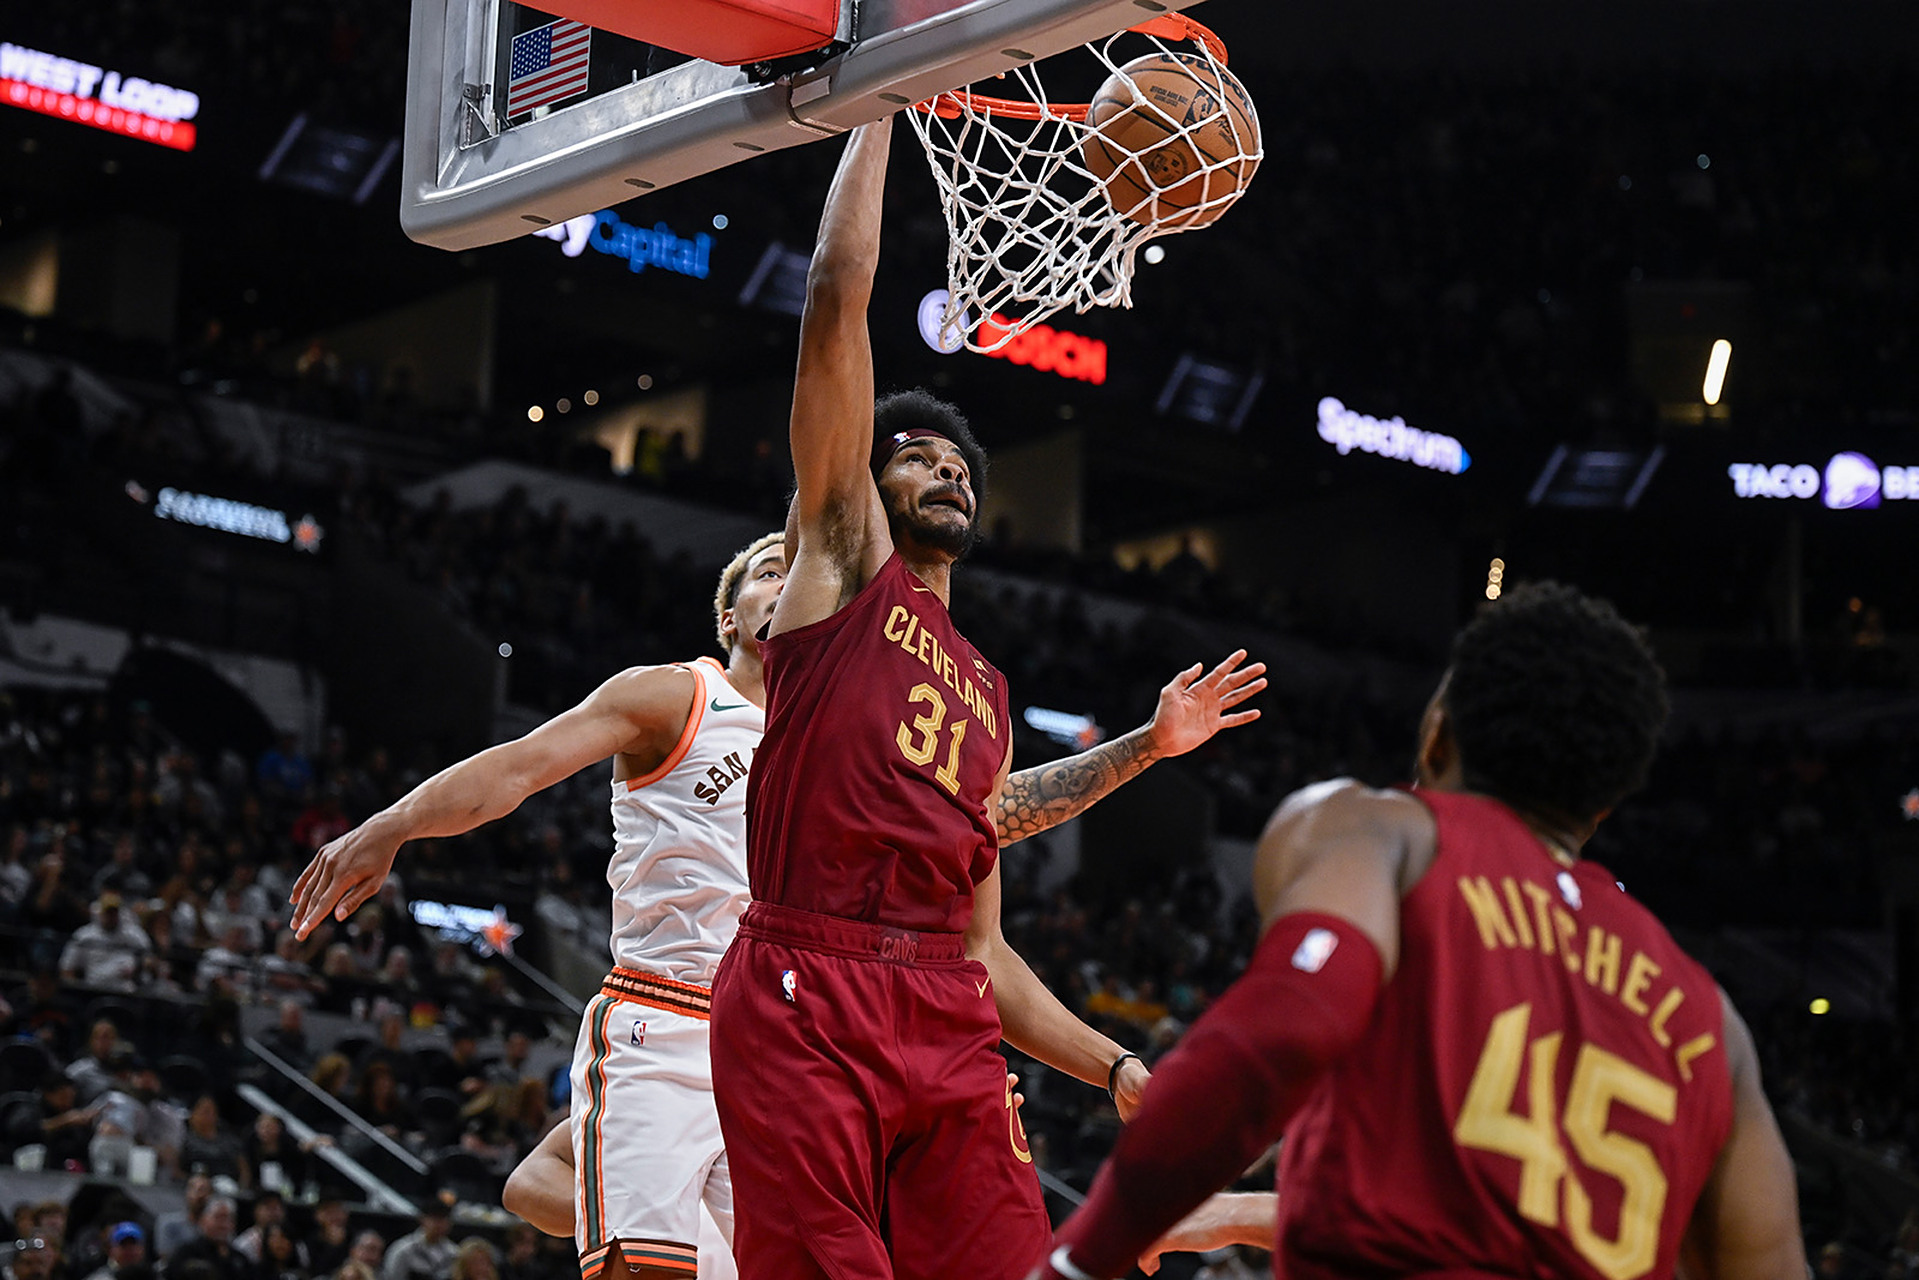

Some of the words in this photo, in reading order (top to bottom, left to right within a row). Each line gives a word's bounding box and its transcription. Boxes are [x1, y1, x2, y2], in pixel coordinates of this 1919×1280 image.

[0, 42, 104, 99] WEST
[100, 70, 200, 123] LOOP
[1317, 396, 1463, 475] Spectrum
[1728, 463, 1820, 498] TACO
[883, 605, 997, 740] CLEVELAND
[693, 751, 749, 807] SAN
[895, 682, 968, 796] 31
[881, 935, 918, 963] CAVS
[1458, 876, 1716, 1083] MITCHELL
[1454, 1002, 1678, 1280] 45
